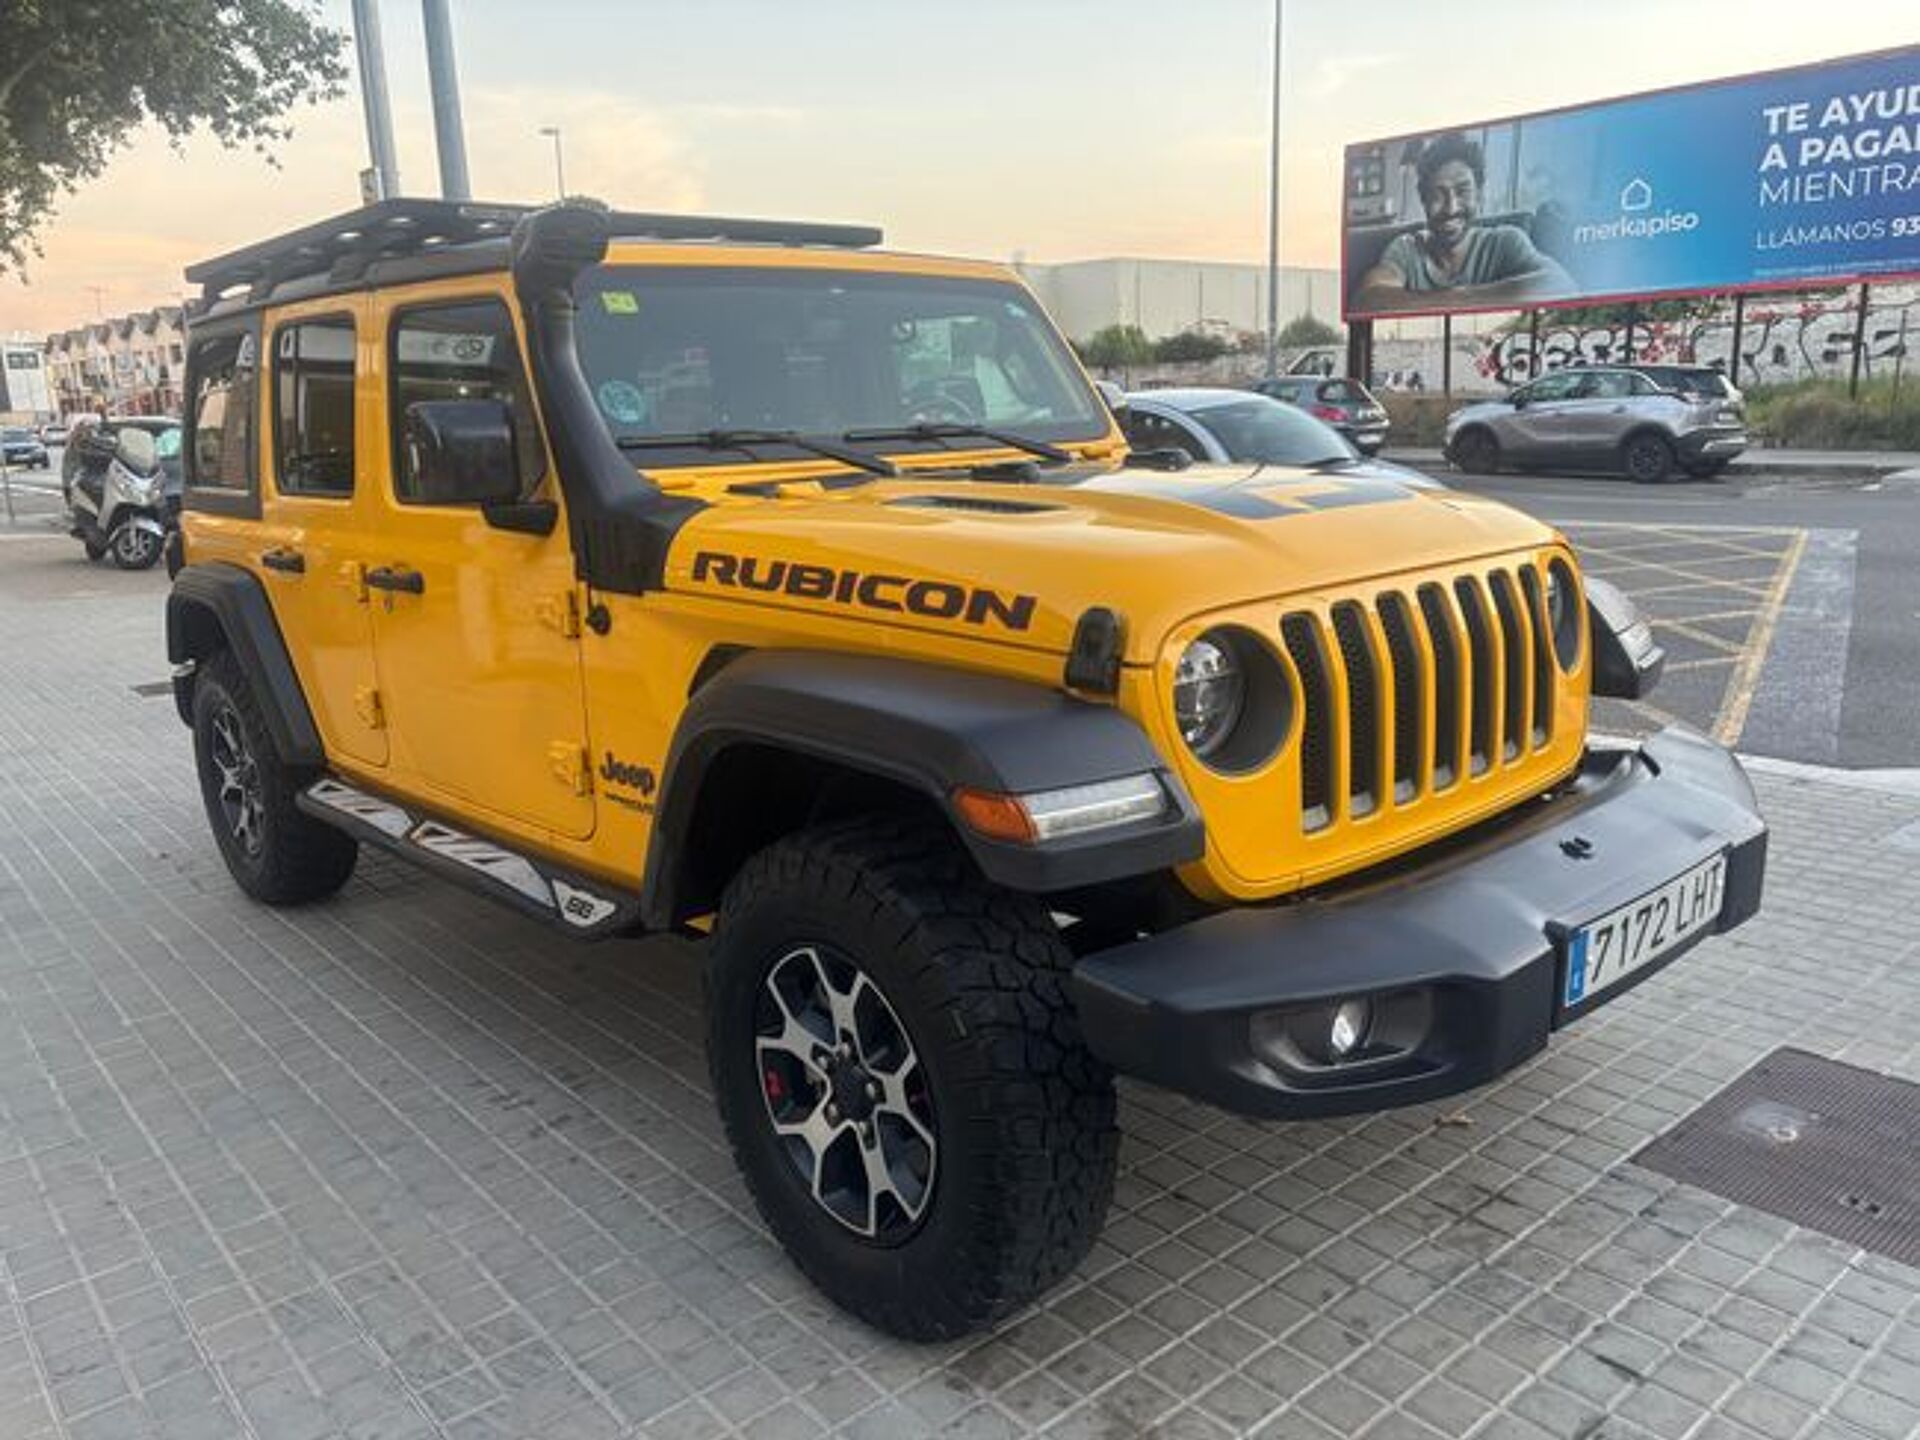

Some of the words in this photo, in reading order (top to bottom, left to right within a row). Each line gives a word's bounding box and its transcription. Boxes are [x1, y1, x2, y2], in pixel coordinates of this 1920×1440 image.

[1763, 102, 1810, 135] TE
[1758, 142, 1788, 172] A
[1799, 123, 1920, 167] PAGA
[1573, 210, 1699, 244] merkapiso
[692, 550, 1038, 631] RUBICON
[600, 751, 656, 797] Jeep
[1591, 896, 1669, 984] 7172
[1675, 861, 1721, 932] LHT
